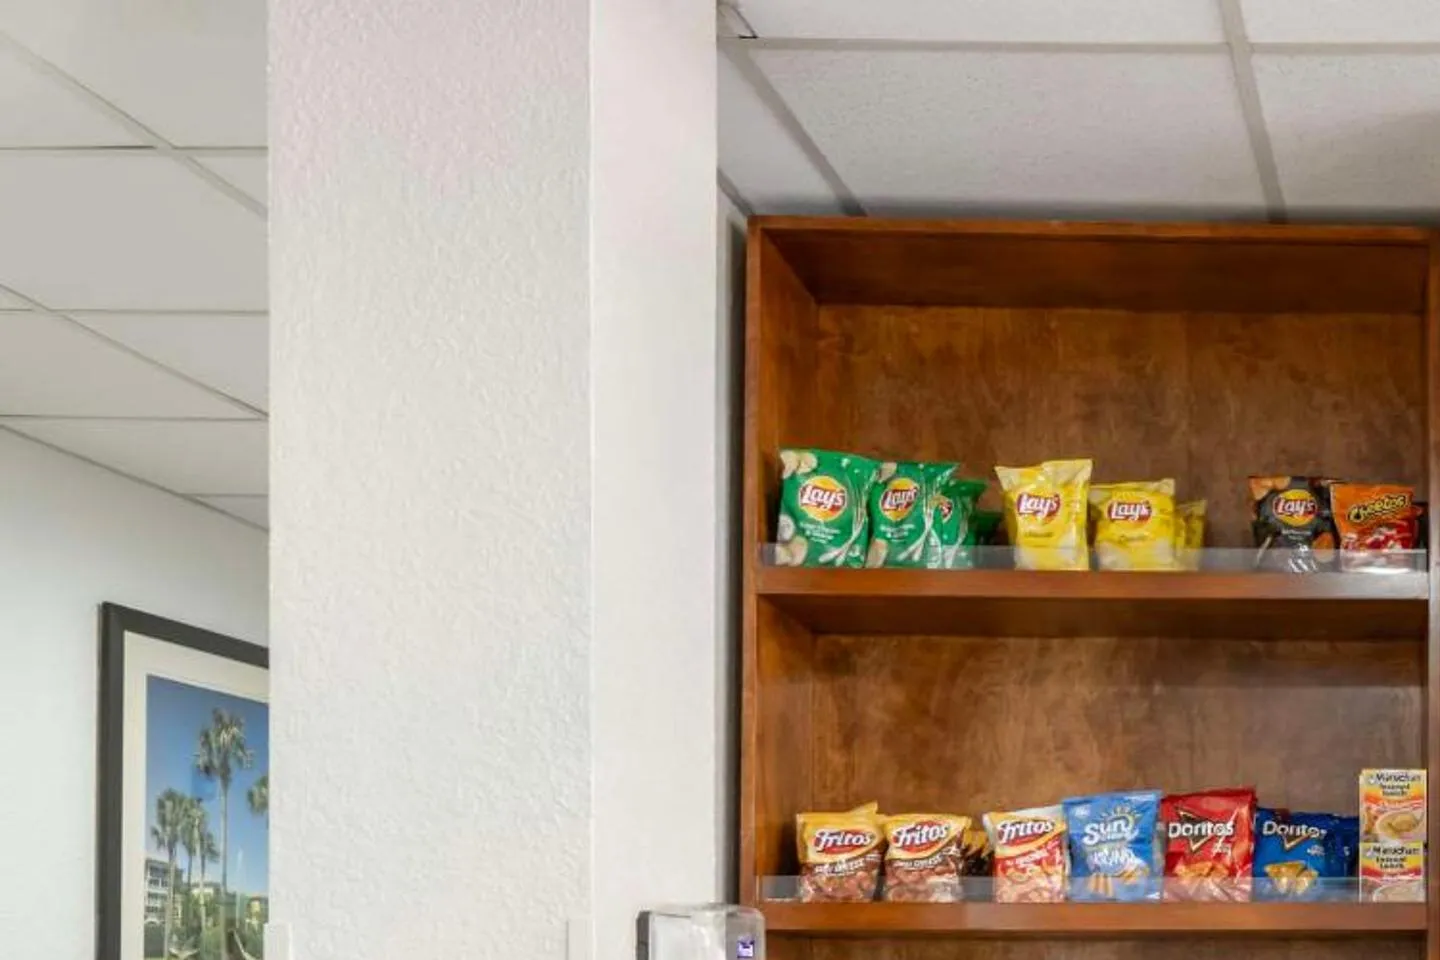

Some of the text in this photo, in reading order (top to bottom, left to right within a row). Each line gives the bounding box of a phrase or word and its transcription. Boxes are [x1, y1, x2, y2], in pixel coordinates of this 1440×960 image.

[800, 482, 847, 512] Lay's
[881, 485, 918, 510] Lay's
[1017, 491, 1061, 517] Lay's
[814, 828, 873, 851] Fritos
[892, 820, 949, 847] Fritos
[998, 819, 1055, 847] Fritos
[1082, 818, 1128, 846] Sun
[1168, 819, 1235, 839] Doritos
